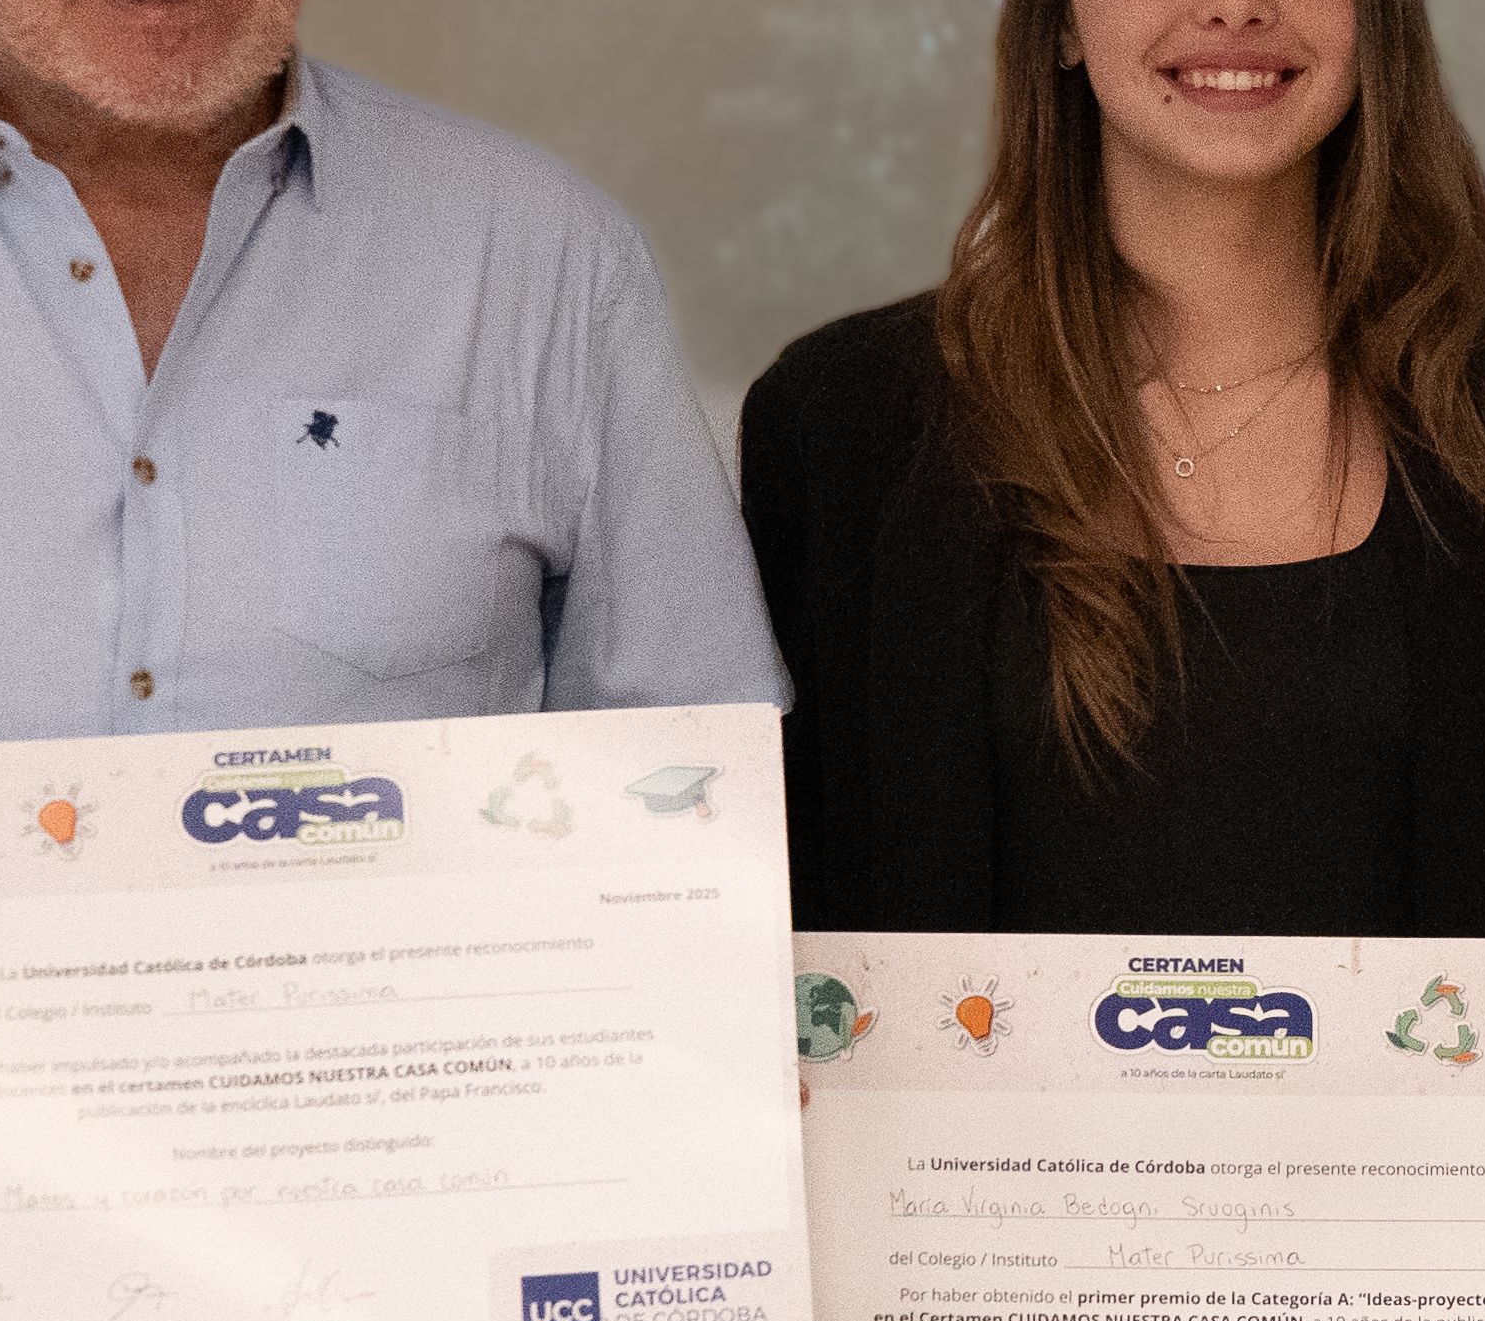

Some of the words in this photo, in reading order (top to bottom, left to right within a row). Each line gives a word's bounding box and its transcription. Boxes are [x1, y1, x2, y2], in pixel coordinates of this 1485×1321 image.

[214, 747, 332, 767] CERTAMEN
[1128, 957, 1244, 973] CERTAMEN
[1119, 982, 1195, 996] Cuidamos
[1198, 984, 1252, 996] nuestra
[1095, 992, 1313, 1051] casa
[1211, 1028, 1307, 1057] común
[907, 1158, 926, 1172] La
[930, 1157, 1032, 1172] Universidad
[1036, 1158, 1105, 1173] Católica
[1109, 1159, 1130, 1174] de
[1134, 1159, 1206, 1175] Córdoba
[1210, 1163, 1263, 1180] otorga
[1267, 1161, 1282, 1176] el
[1285, 1163, 1357, 1179] presente
[888, 1251, 914, 1266] del
[917, 1251, 977, 1271] Colegio
[980, 1253, 988, 1266] /
[991, 1253, 1059, 1268] Instituto
[614, 1261, 772, 1285] UNIVERSIDAD
[615, 1285, 726, 1308] CATÓLICA
[899, 1287, 927, 1303] Por
[931, 1288, 978, 1303] haber
[982, 1289, 1055, 1304] obtenido
[1059, 1291, 1072, 1303] el
[1077, 1291, 1135, 1308] primer
[1140, 1292, 1202, 1308] premio
[1205, 1291, 1227, 1306] de
[1231, 1291, 1247, 1305] la
[1251, 1292, 1333, 1310] Categoría
[1337, 1292, 1353, 1306] A:
